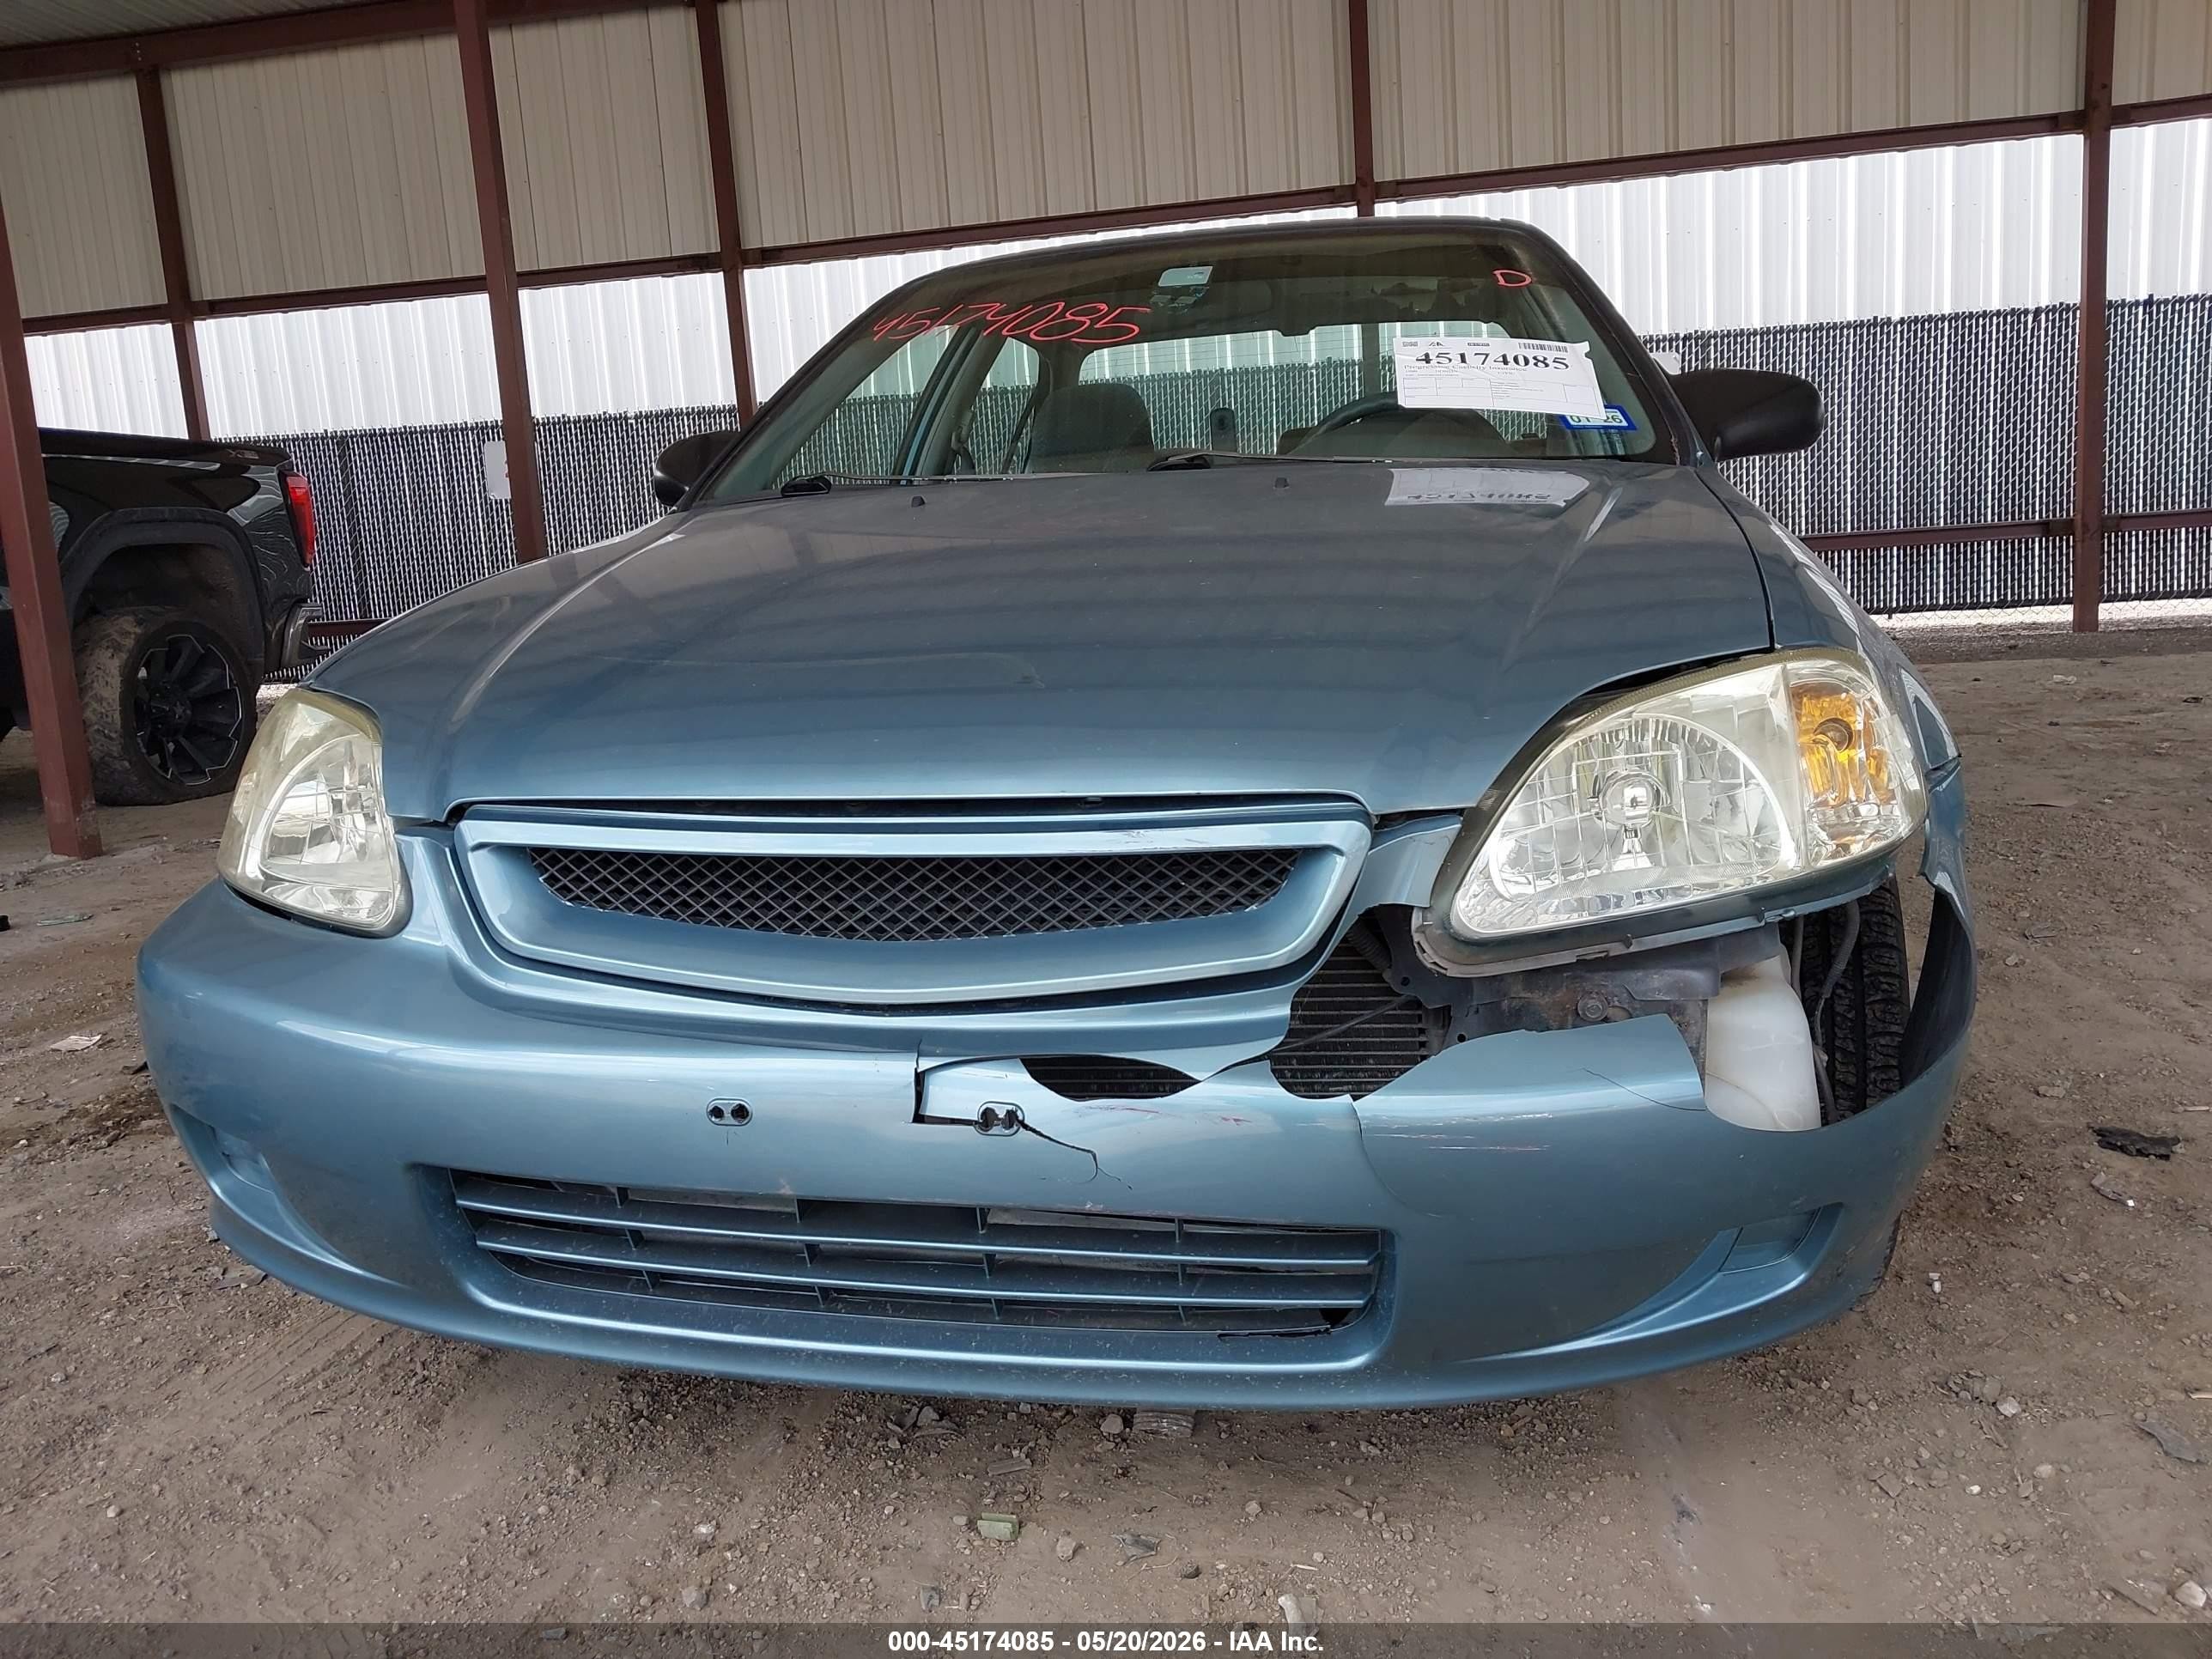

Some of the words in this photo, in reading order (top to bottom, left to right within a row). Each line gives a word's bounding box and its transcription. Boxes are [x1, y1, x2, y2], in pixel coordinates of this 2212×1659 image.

[1493, 270, 1531, 286] D
[873, 301, 1152, 343] 45174085
[1415, 352, 1570, 370] 45174085
